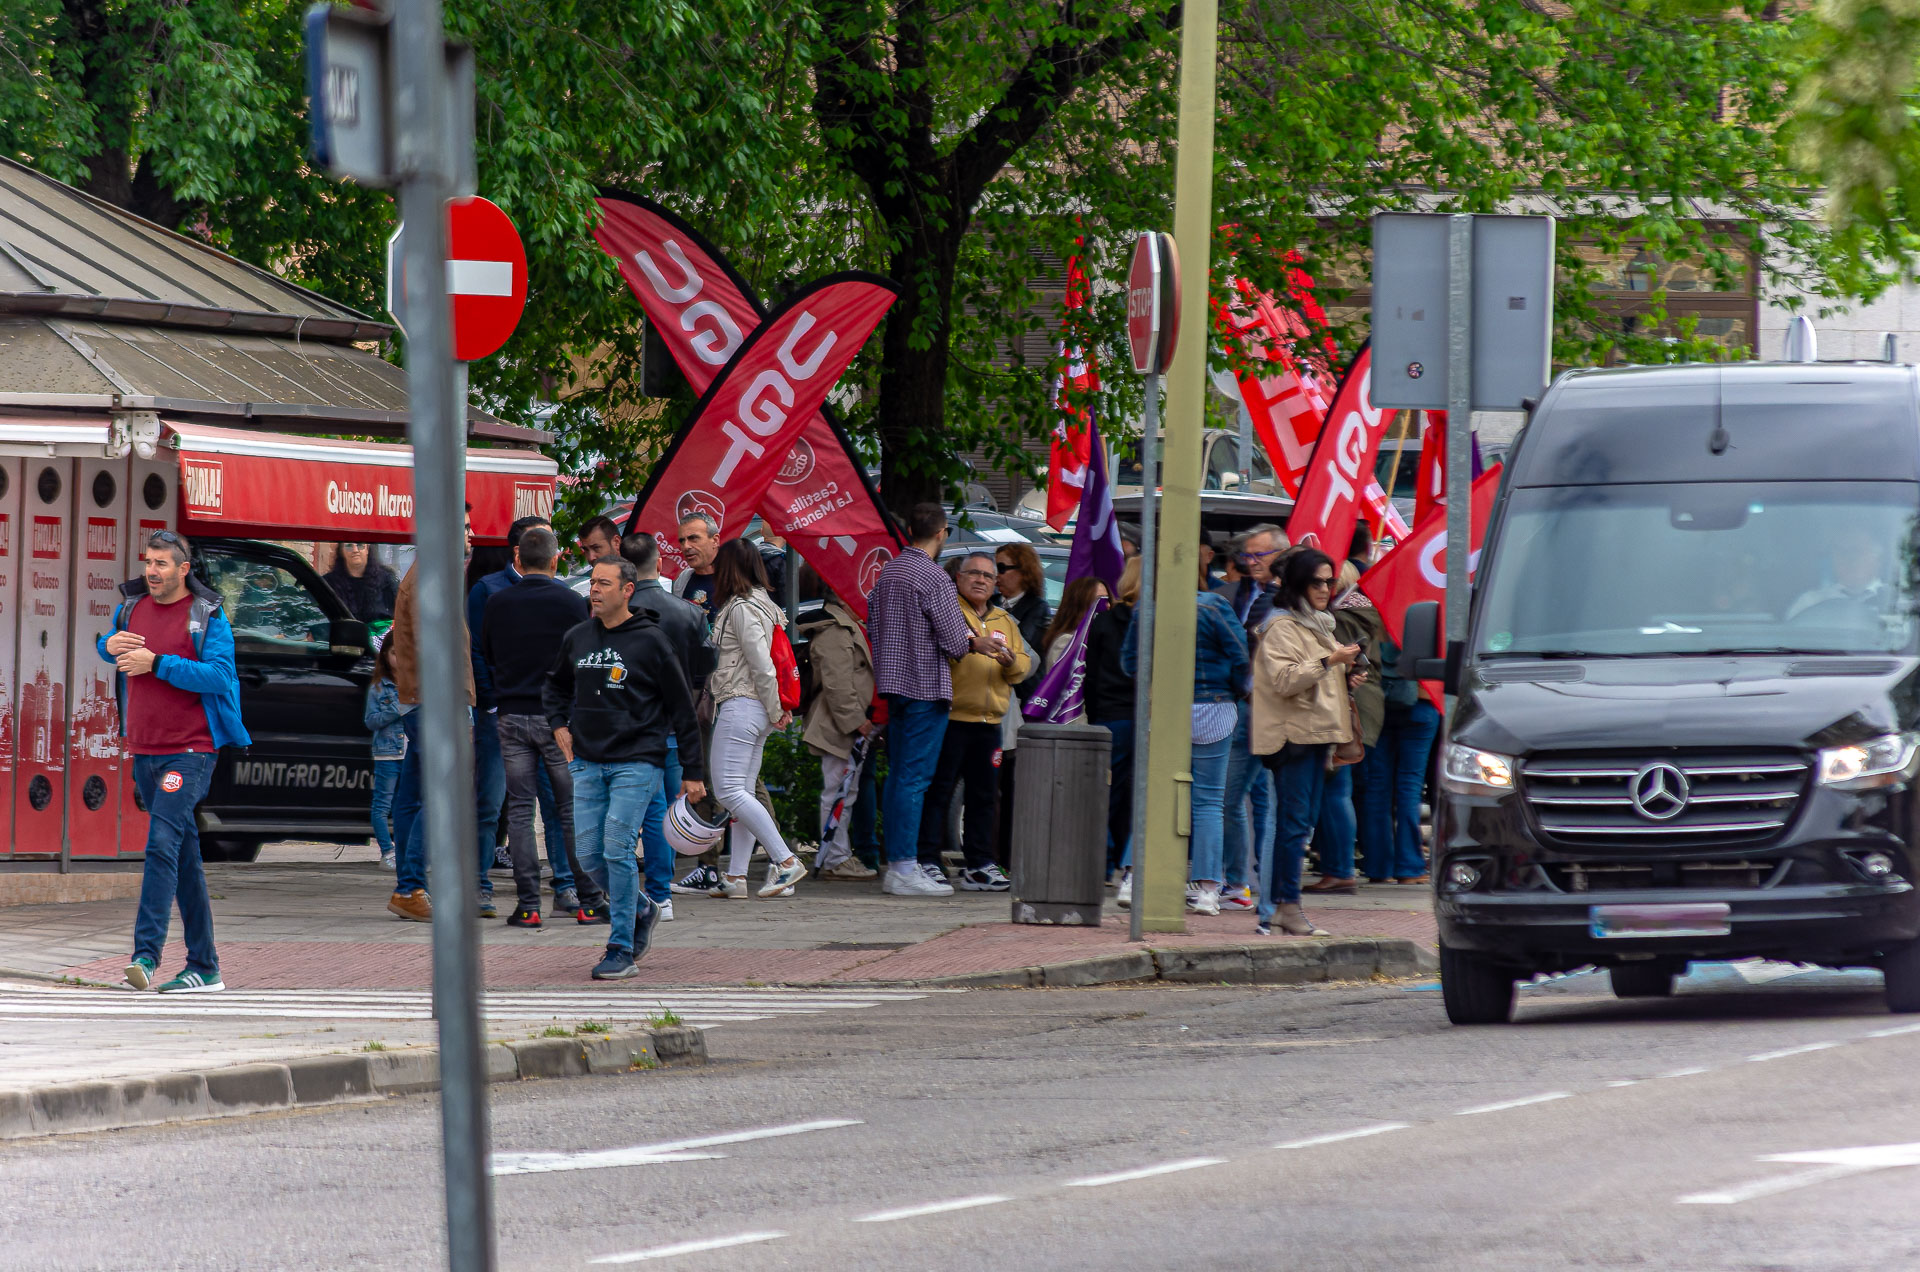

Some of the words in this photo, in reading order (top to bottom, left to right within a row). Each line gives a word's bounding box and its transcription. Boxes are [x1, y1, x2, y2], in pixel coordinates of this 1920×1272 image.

[1131, 287, 1152, 319] STOP
[711, 310, 838, 488] UGT
[327, 480, 374, 516] Quiosco
[378, 484, 413, 518] Marco
[33, 571, 59, 590] Quiosco
[88, 572, 114, 591] Quiosco
[35, 598, 56, 616] Marco
[90, 599, 110, 617] Marco
